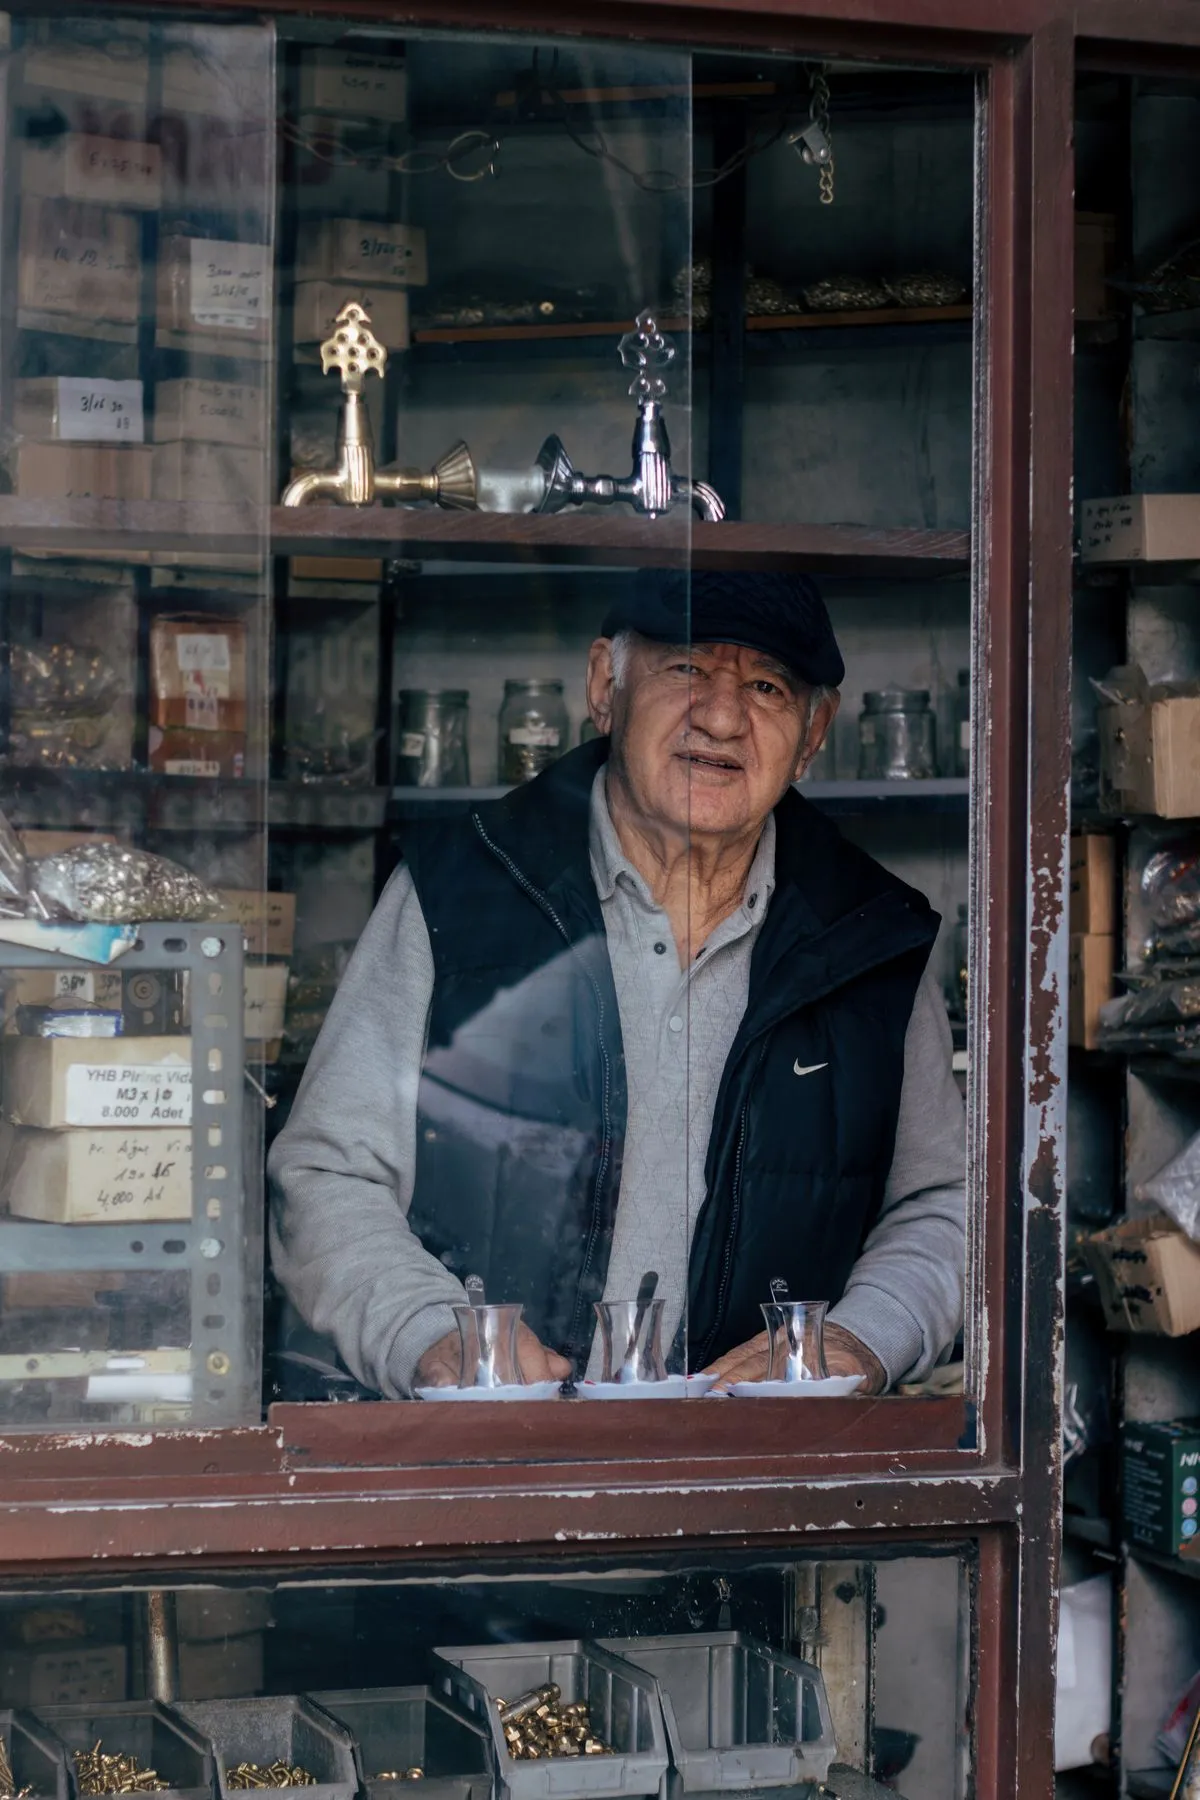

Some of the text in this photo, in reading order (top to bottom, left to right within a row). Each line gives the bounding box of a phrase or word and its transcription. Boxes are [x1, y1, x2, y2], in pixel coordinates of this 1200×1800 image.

[87, 1070, 117, 1082] YHB
[101, 1106, 184, 1119] 8.000 Adet
